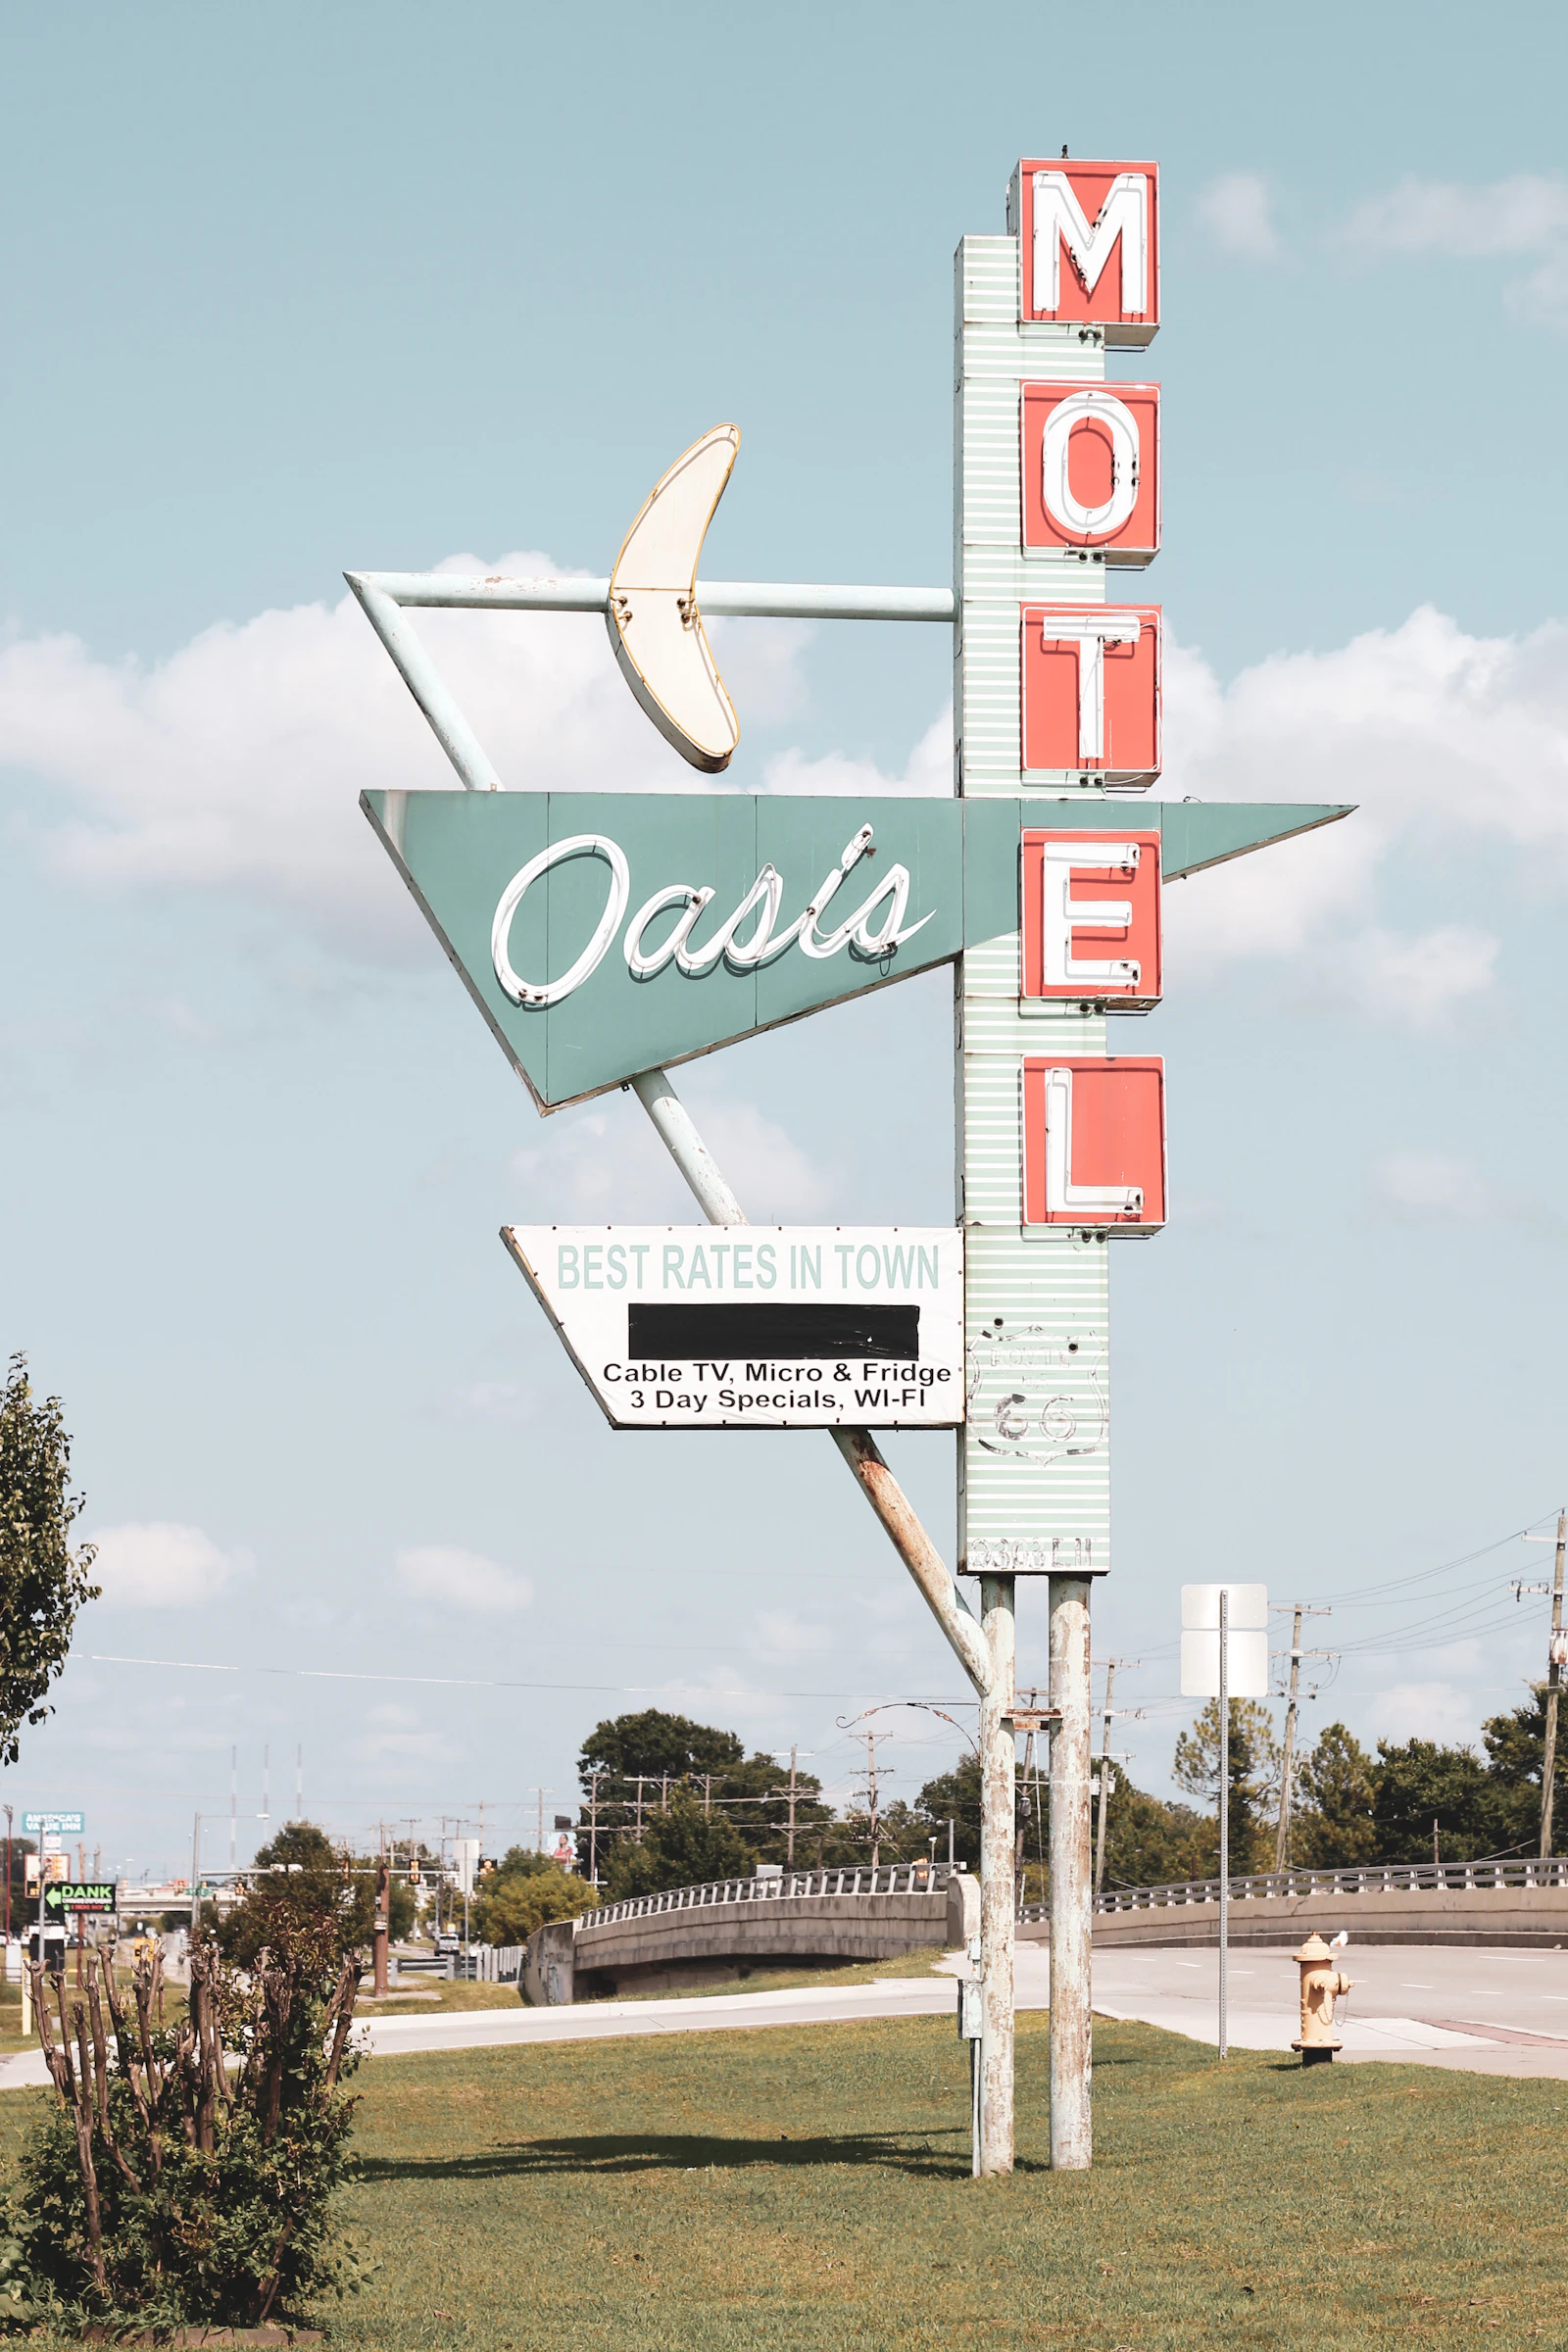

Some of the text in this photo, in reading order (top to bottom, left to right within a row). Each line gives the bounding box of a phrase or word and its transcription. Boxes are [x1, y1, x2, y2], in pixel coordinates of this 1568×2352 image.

[1033, 171, 1147, 1212] MOTEL
[492, 822, 936, 1004] Oasis
[558, 1245, 938, 1290] BEST RATES IN TOWN
[603, 1363, 952, 1387] Cable TV, Micro & Fridge
[630, 1389, 925, 1412] 3 Day Specials, WI-FI
[994, 1394, 1076, 1442] 66
[62, 1822, 81, 1831] INN
[62, 1886, 112, 1897] DANK
